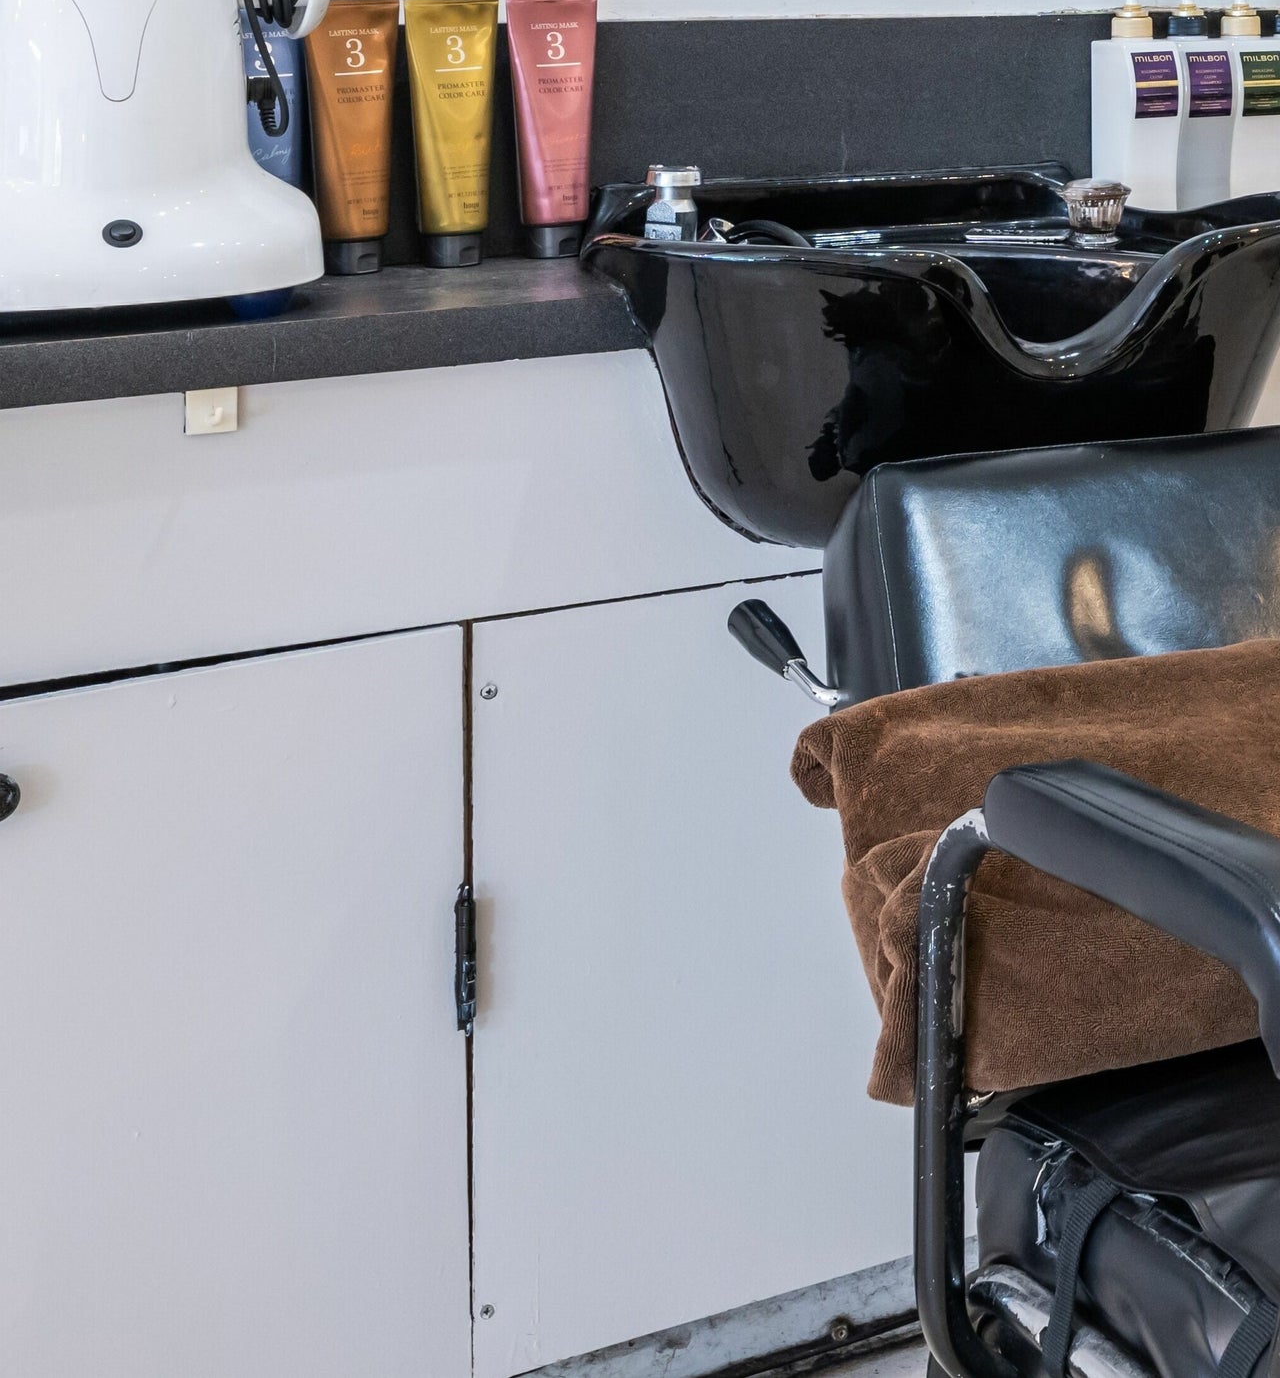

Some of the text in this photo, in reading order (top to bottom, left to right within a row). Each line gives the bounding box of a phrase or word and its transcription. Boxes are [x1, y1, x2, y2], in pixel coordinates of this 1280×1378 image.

[328, 28, 380, 37] LASTING MASK
[430, 26, 459, 34] LASTING
[446, 35, 466, 64] 3
[546, 31, 566, 60] 3
[345, 38, 366, 68] 3
[1134, 54, 1172, 62] MILBON
[1189, 54, 1227, 62] MILBON
[1243, 54, 1280, 62] MILBON
[437, 80, 485, 90] PROMASTER
[538, 76, 584, 85] PROMASTER
[336, 84, 385, 95] PROMASTER
[538, 86, 563, 94] COLOR
[337, 95, 364, 104] COLOR
[438, 90, 464, 100] COLOR
